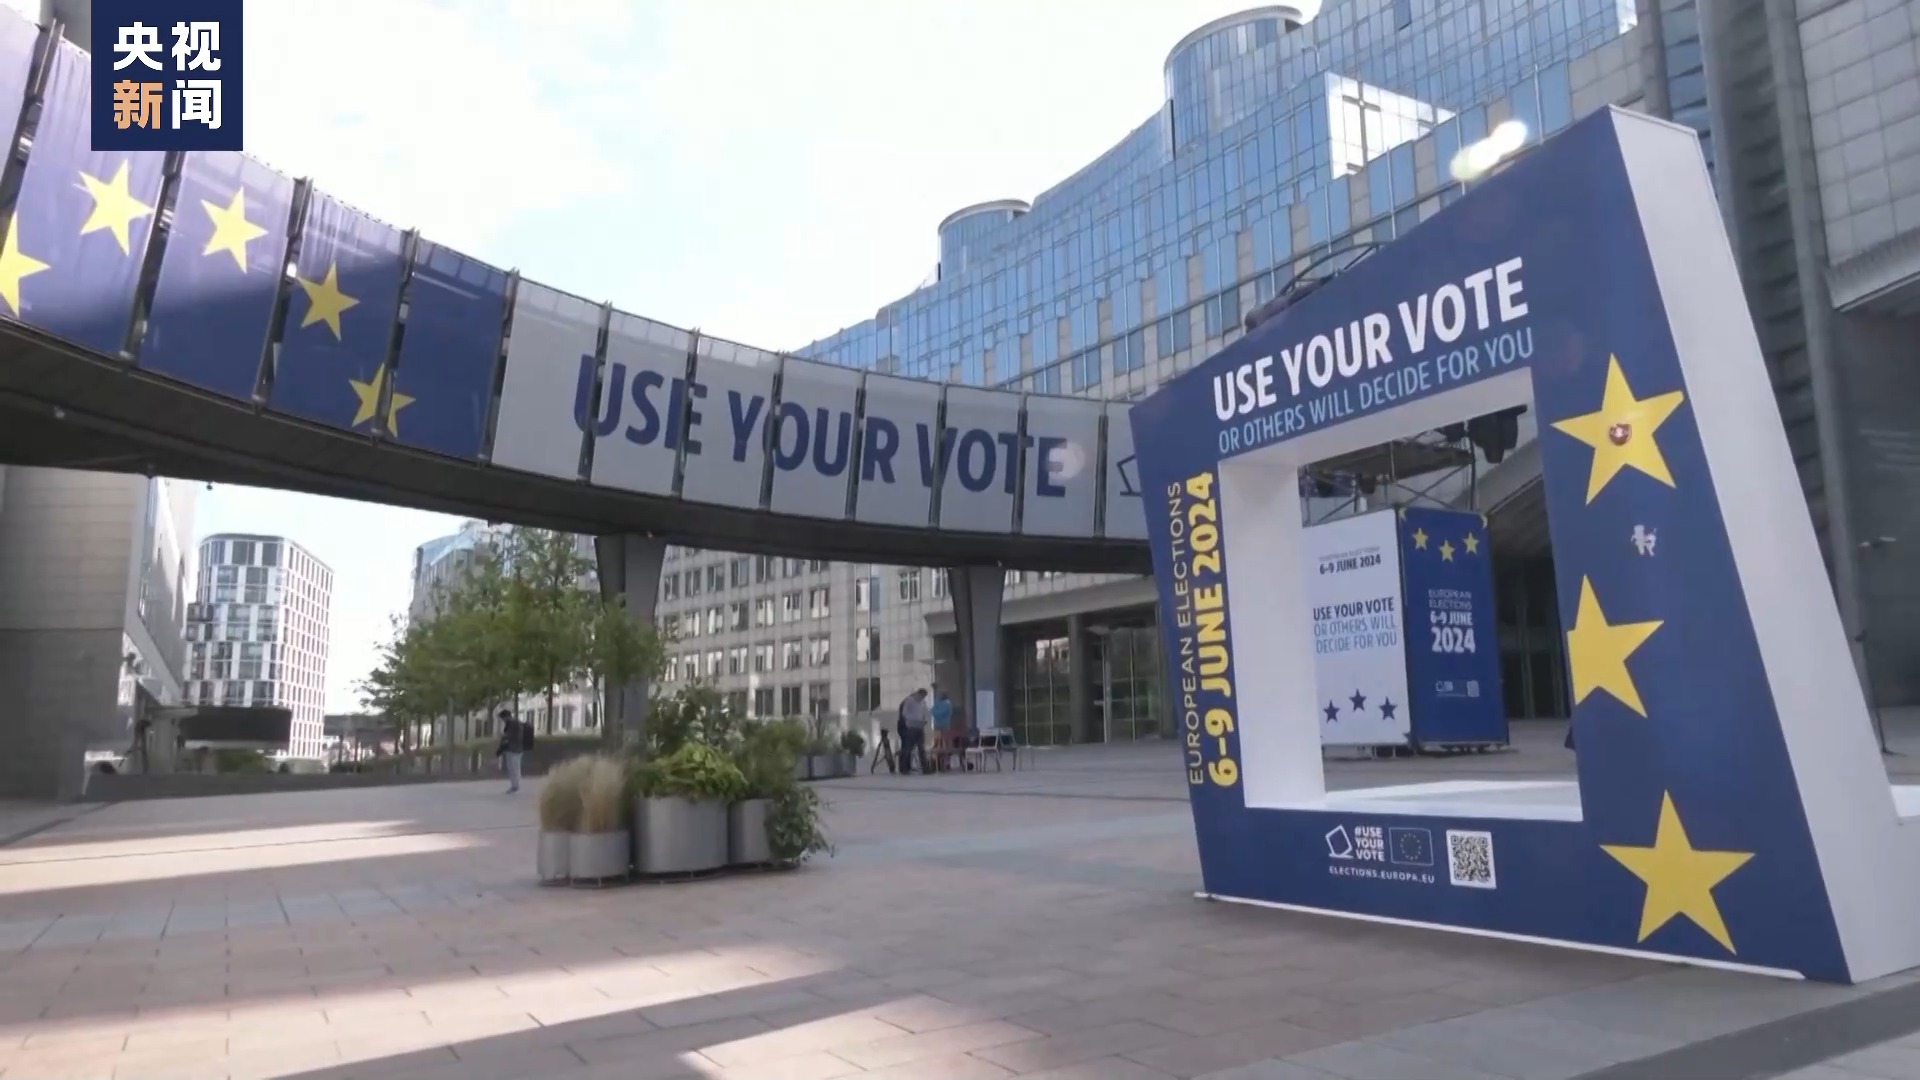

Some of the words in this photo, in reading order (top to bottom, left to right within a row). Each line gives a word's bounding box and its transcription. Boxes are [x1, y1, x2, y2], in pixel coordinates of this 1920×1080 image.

[1213, 356, 1277, 421] USE
[1281, 312, 1392, 396] YOUR
[1398, 256, 1529, 355] VOTE
[1218, 430, 1240, 454] OR
[1243, 403, 1304, 446] OTHERS
[1308, 391, 1355, 425] WILL
[1359, 360, 1432, 411] DECIDE
[1436, 347, 1480, 385] FOR
[1484, 327, 1534, 368] YOU
[573, 353, 707, 456] USE
[727, 390, 900, 485] YOUR
[915, 422, 1068, 498] VOTE
[1185, 472, 1221, 577] 2024
[1167, 481, 1191, 628] ELECTIONS
[1336, 558, 1358, 573] JUNE
[1360, 553, 1381, 568] 2024
[1313, 606, 1332, 621] USE
[1334, 601, 1363, 618] YOUR
[1365, 596, 1394, 614] VOTE
[1430, 610, 1447, 624] 6-9
[1449, 611, 1473, 626] JUNE
[1314, 622, 1327, 637] OR
[1329, 617, 1368, 635] OTHERS
[1370, 614, 1396, 630] WILL
[1194, 583, 1231, 698] JUNE
[1316, 637, 1350, 654] DECIDE
[1353, 634, 1373, 650] FOR
[1376, 631, 1397, 648] YOU
[1431, 626, 1476, 653] 2024
[1181, 637, 1204, 785] EUROPEAN
[1204, 708, 1238, 787] 6-9
[1354, 826, 1383, 838] #USE
[1355, 838, 1384, 850] YOUR
[1355, 849, 1385, 862] VOTE
[1329, 865, 1435, 884] ELECTIONS.EUROPA.EU
